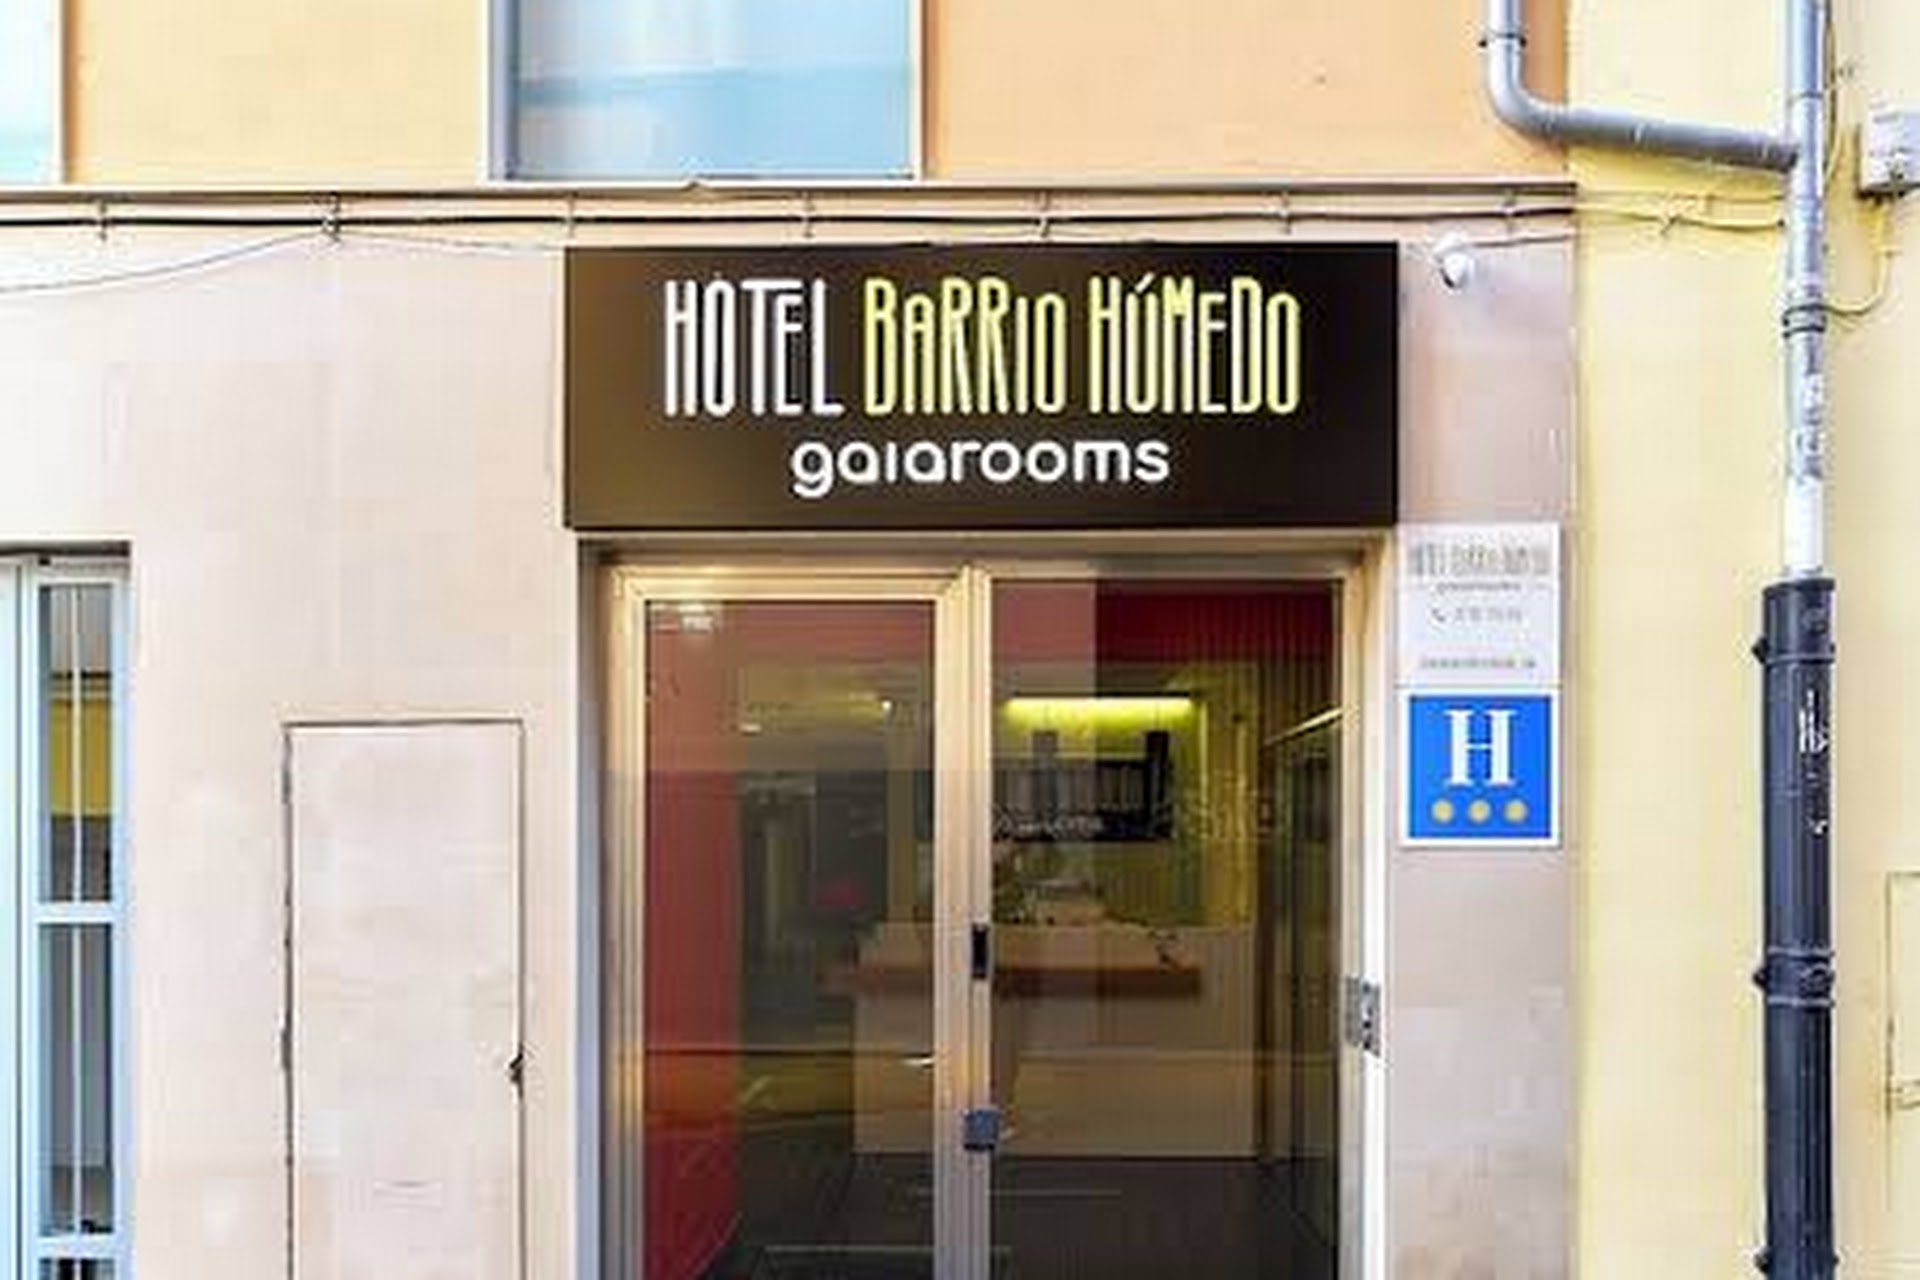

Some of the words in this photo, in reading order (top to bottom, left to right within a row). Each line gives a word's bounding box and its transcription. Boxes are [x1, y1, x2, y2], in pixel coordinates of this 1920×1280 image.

[664, 278, 845, 418] HOTEL
[1089, 272, 1300, 415] HÚMEDO
[791, 440, 1171, 498] gaiarooms
[1442, 709, 1518, 786] H
